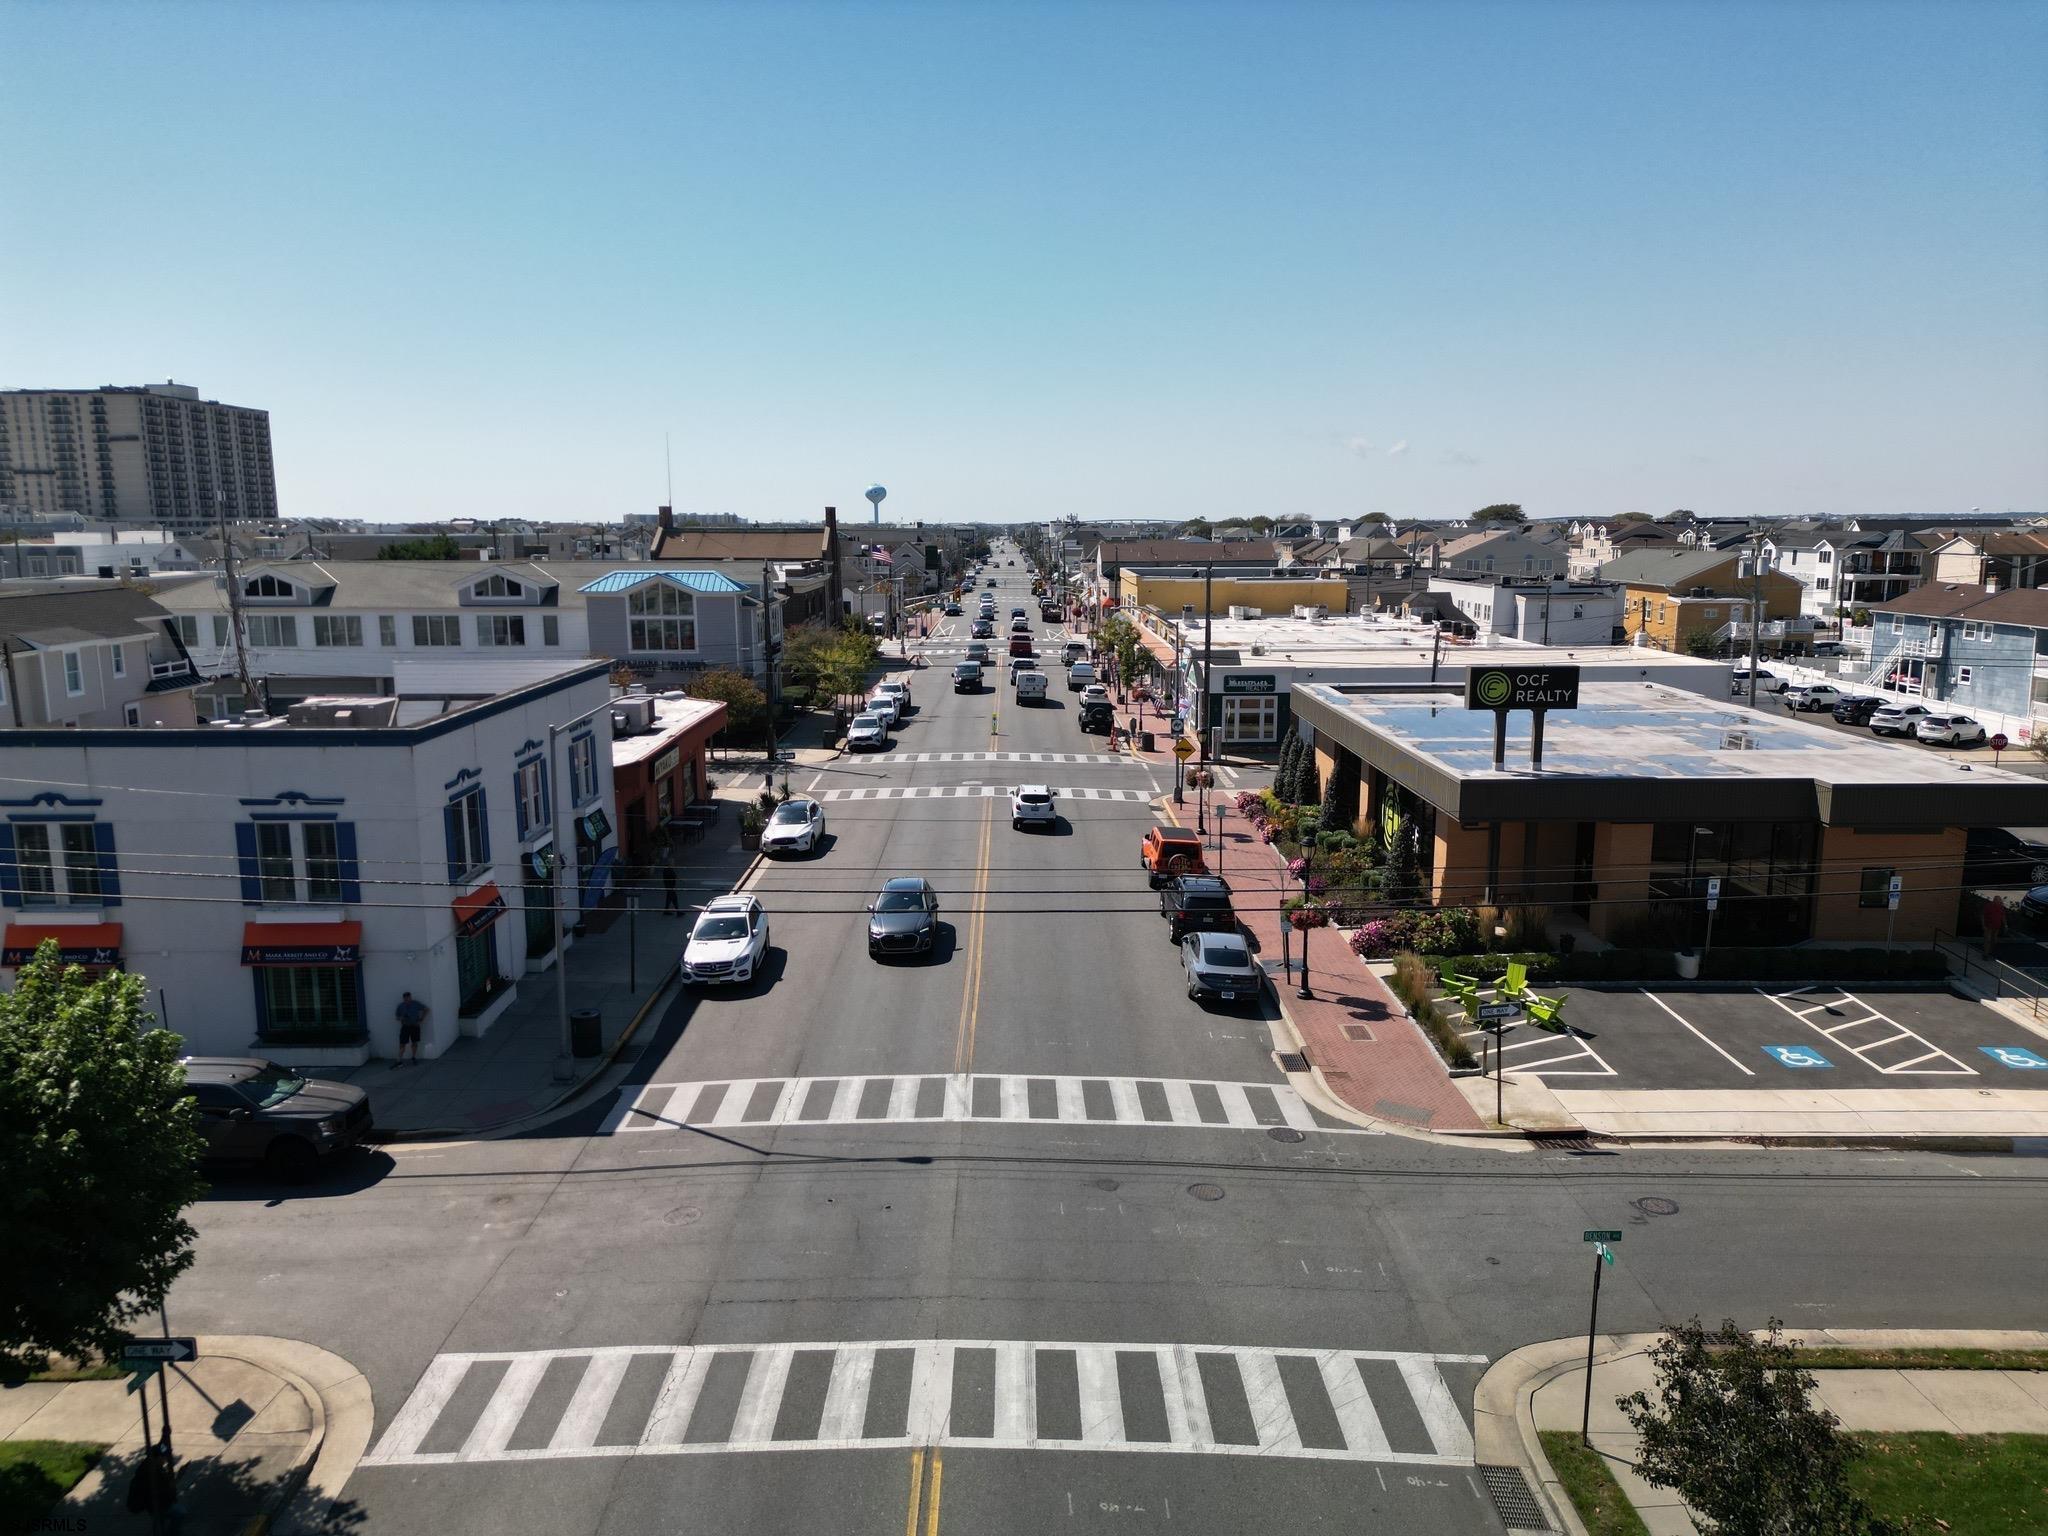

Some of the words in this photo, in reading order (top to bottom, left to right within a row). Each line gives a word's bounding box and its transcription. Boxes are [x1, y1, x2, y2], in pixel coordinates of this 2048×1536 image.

[1516, 674, 1549, 686] OCF
[1516, 690, 1572, 702] REALTY
[1991, 738, 2007, 746] STOP
[1585, 1231, 1611, 1241] BENSON
[151, 1346, 172, 1356] WAY
